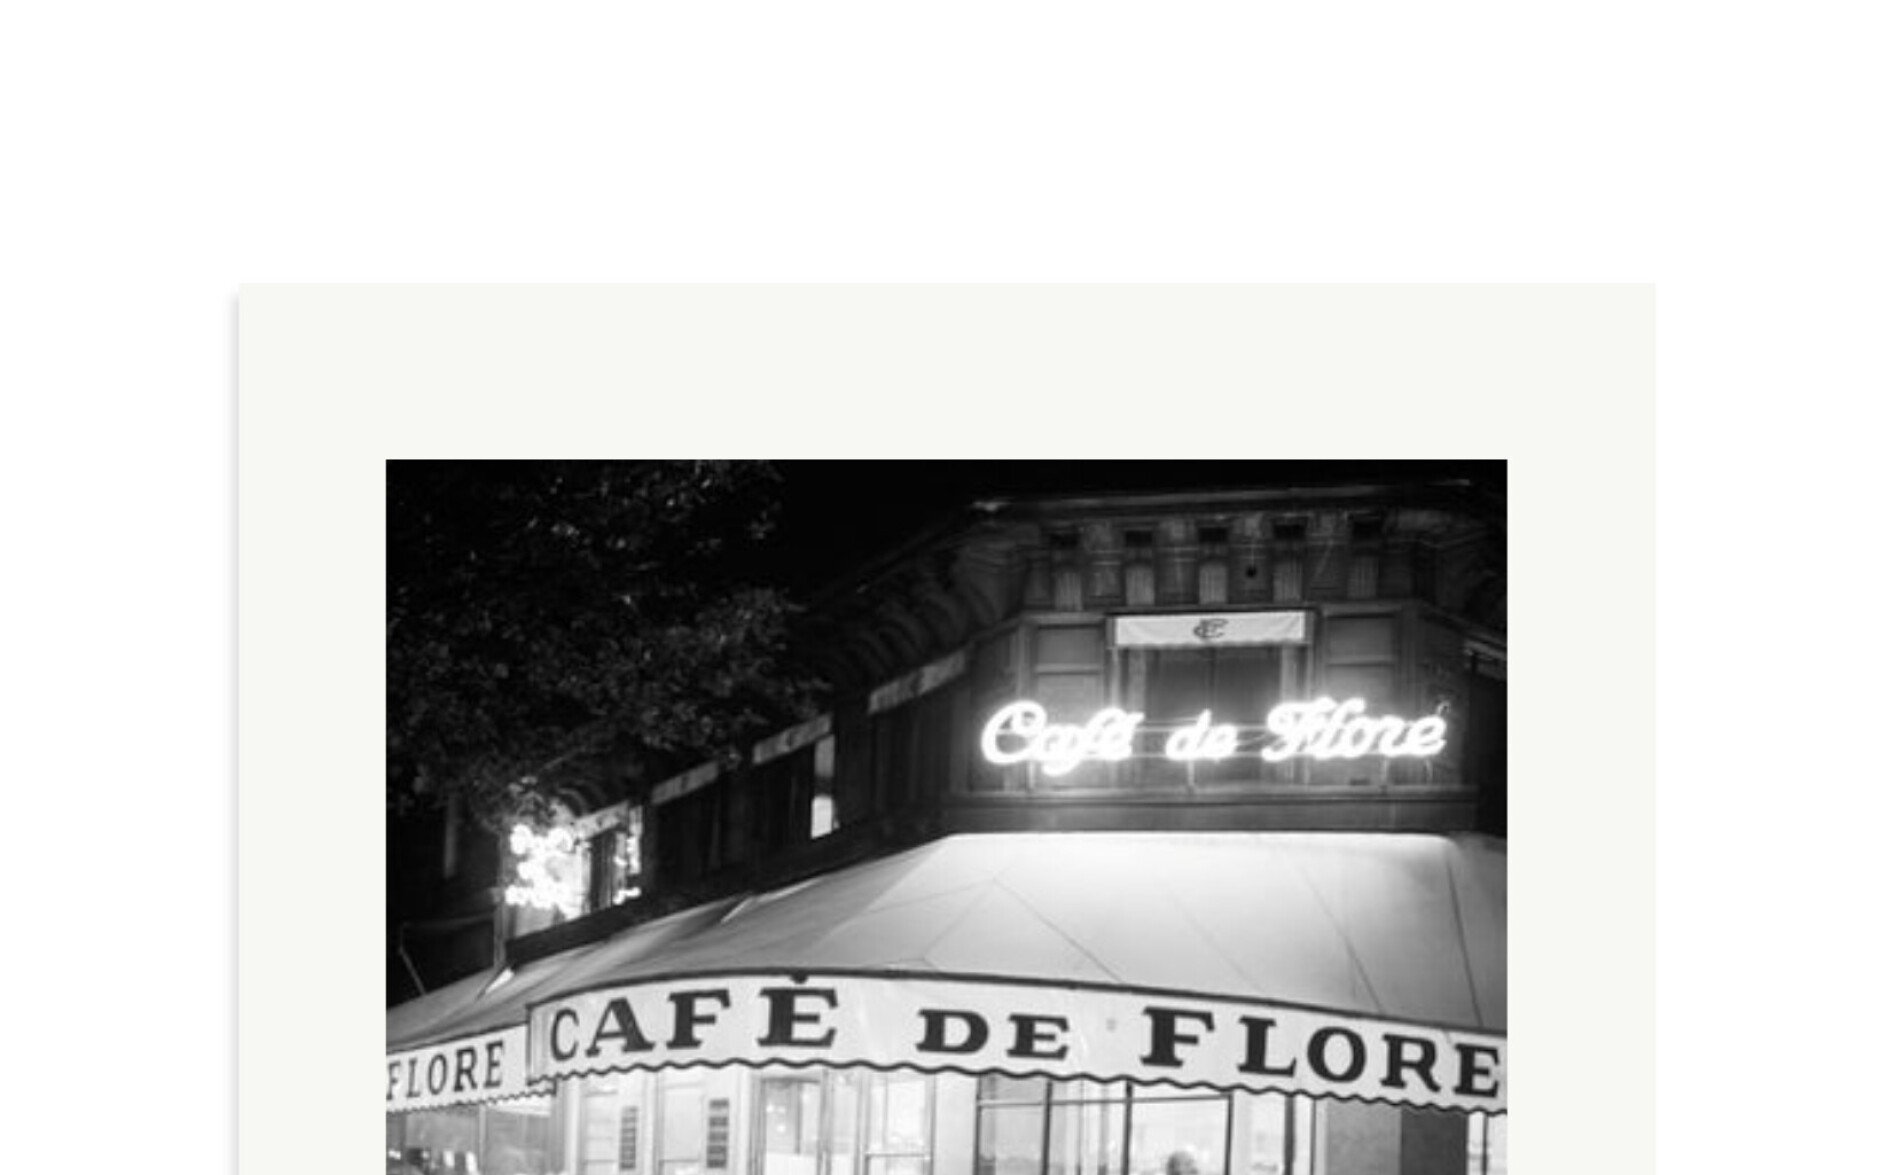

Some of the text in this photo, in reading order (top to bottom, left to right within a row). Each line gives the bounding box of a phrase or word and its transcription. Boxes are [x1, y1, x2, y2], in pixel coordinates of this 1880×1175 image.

[981, 696, 1448, 777] Café de Flore
[386, 1040, 503, 1100] FLORE
[916, 1008, 1071, 1061] DE
[1141, 1005, 1500, 1098] FLORE
